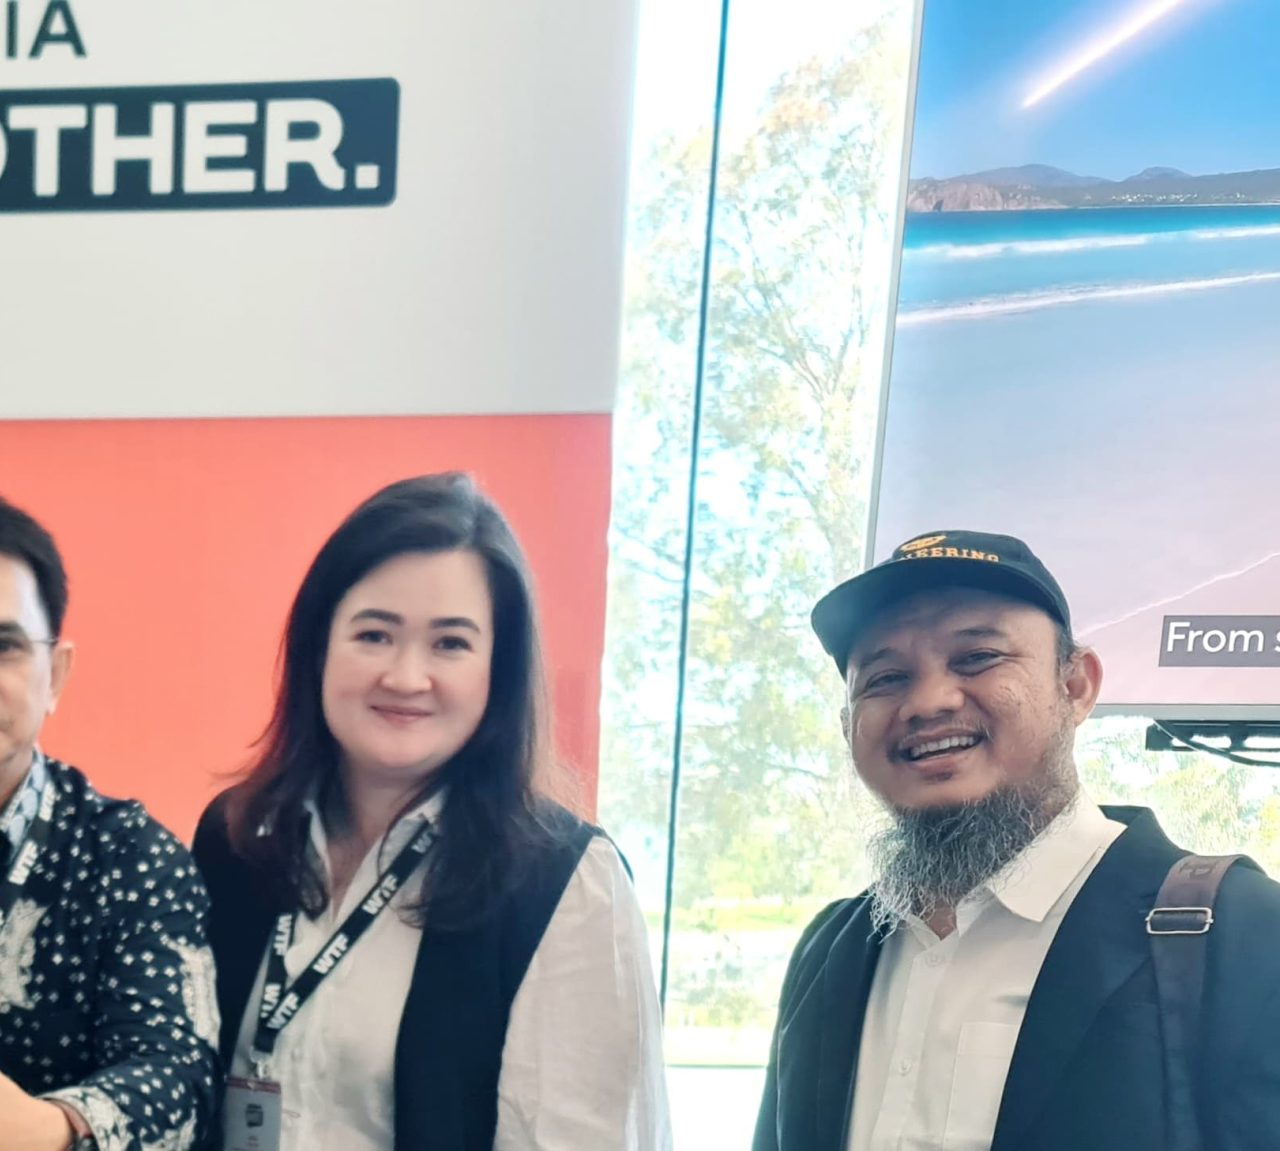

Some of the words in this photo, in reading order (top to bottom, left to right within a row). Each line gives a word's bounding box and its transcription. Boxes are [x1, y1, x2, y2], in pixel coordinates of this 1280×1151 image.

[1166, 621, 1264, 652] From
[8, 840, 39, 886] WTF
[363, 874, 399, 916] WTF
[274, 914, 294, 957] WTF
[313, 933, 349, 975] WTF
[267, 992, 301, 1030] WTF
